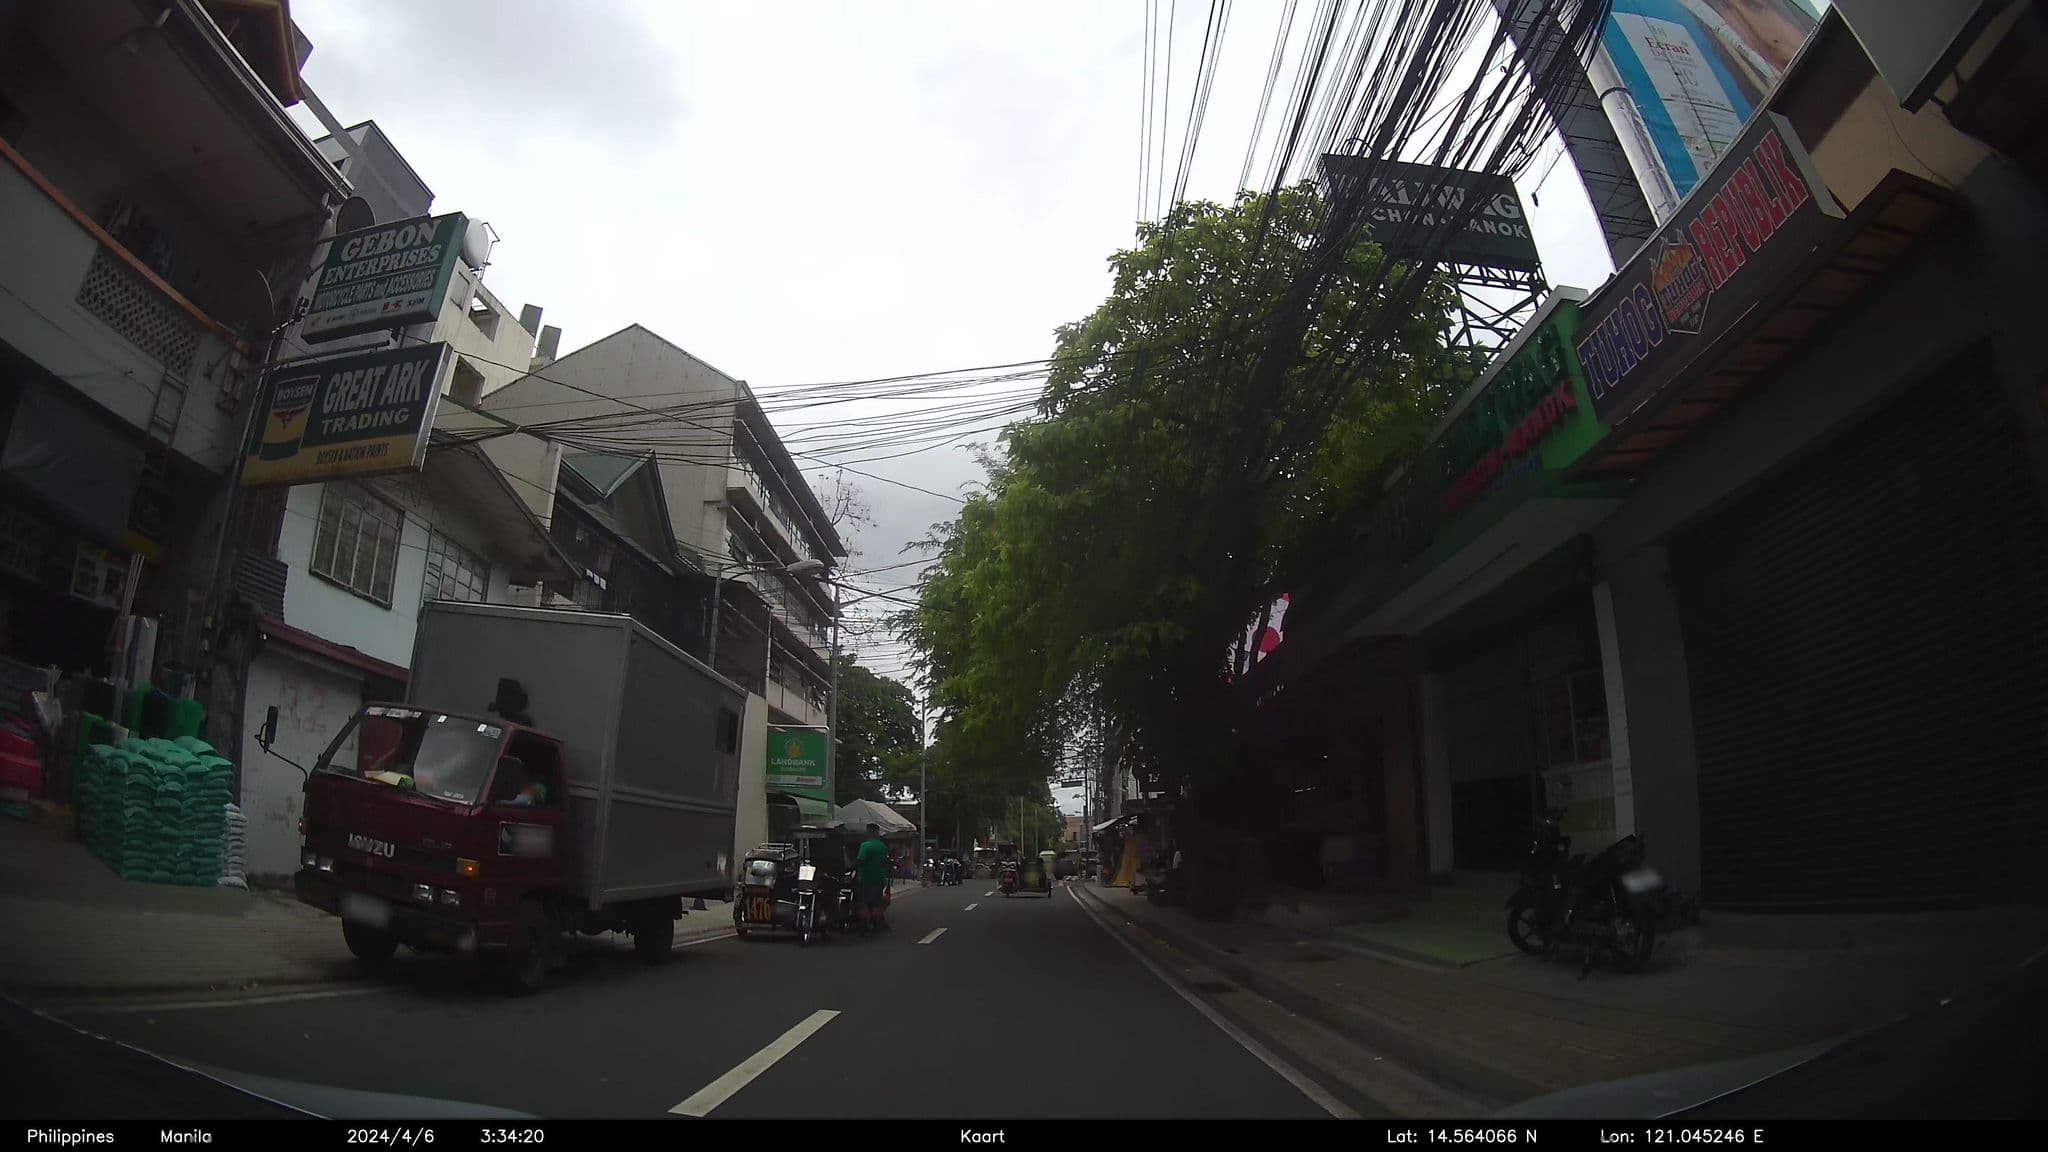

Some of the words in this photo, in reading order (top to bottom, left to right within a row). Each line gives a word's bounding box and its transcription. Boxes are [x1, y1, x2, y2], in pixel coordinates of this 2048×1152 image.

[1645, 36, 1690, 55] Ecran
[341, 219, 441, 262] GEBON
[323, 244, 441, 285] ENTERPRISES
[1576, 282, 1663, 400] TUHOG
[1689, 129, 1809, 290] REPUBLIK
[1659, 257, 1702, 304] TUHOG
[277, 383, 313, 401] BOYSEN
[323, 366, 387, 414] GREAT
[380, 359, 429, 405] ARK
[322, 407, 409, 435] TRADING
[771, 757, 816, 767] LANDBANK
[347, 832, 395, 858] ISUZU
[746, 895, 773, 922] 1476
